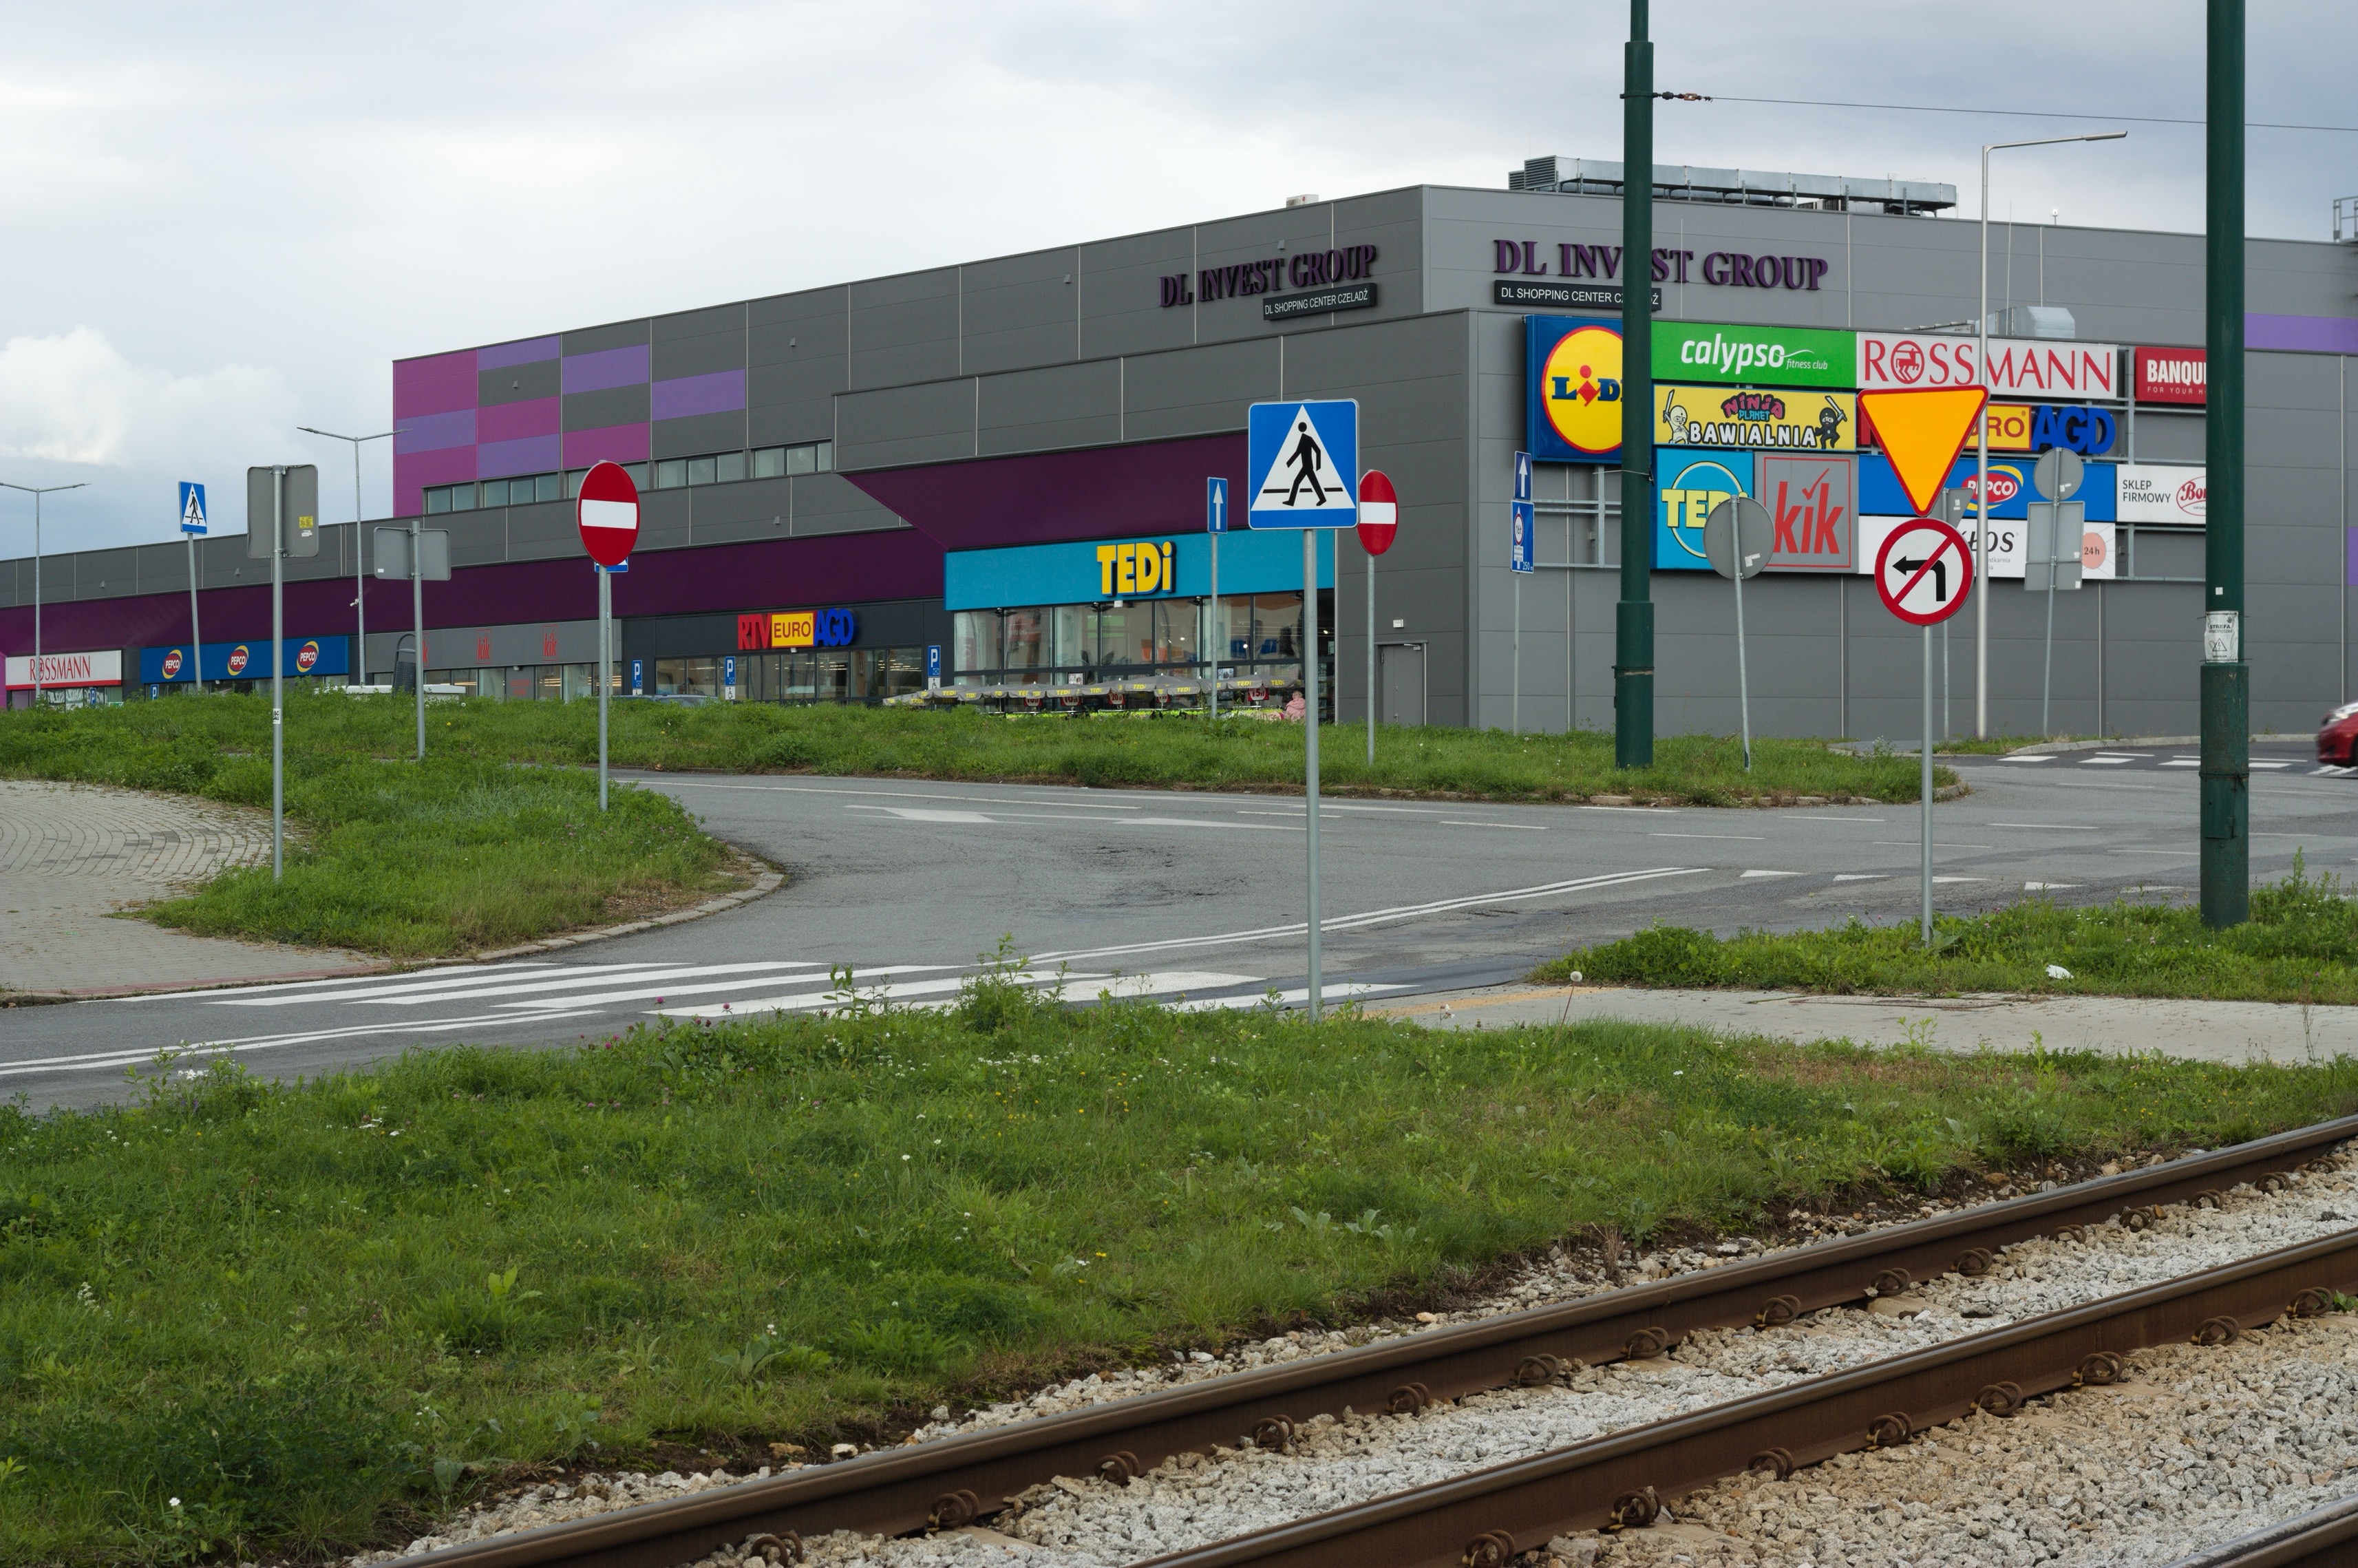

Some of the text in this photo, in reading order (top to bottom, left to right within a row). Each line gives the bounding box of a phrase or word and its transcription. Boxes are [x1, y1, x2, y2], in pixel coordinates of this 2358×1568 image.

[1159, 244, 1377, 307] DL INVEST GROUP
[1494, 240, 1828, 290] DL INVST GROUP
[1265, 288, 1368, 315] DL SHOPPING CENTER CZELADŹ
[1501, 287, 1514, 298] DL
[1516, 288, 1569, 300] SHOPPING
[1571, 290, 1612, 303] CENTER
[1681, 333, 1785, 374] calypso
[1786, 359, 1828, 370] fitness club
[1865, 339, 2110, 392] ROSSMANN
[2147, 359, 2207, 385] BANQU
[2170, 387, 2193, 395] YOUR
[1739, 410, 1770, 421] PLANET
[1689, 421, 1818, 447] BAWIALNIA
[1971, 405, 2116, 455] RO AGD
[1968, 480, 2013, 496] PPCO
[2123, 479, 2152, 490] SKLEP
[2123, 492, 2171, 503] FIRMOWY
[1096, 540, 1176, 597] TEDi
[738, 608, 856, 650] RTV EURO AGD
[165, 659, 180, 669] PEPCO
[231, 655, 246, 666] PEPCO
[300, 651, 315, 661] PEPCO
